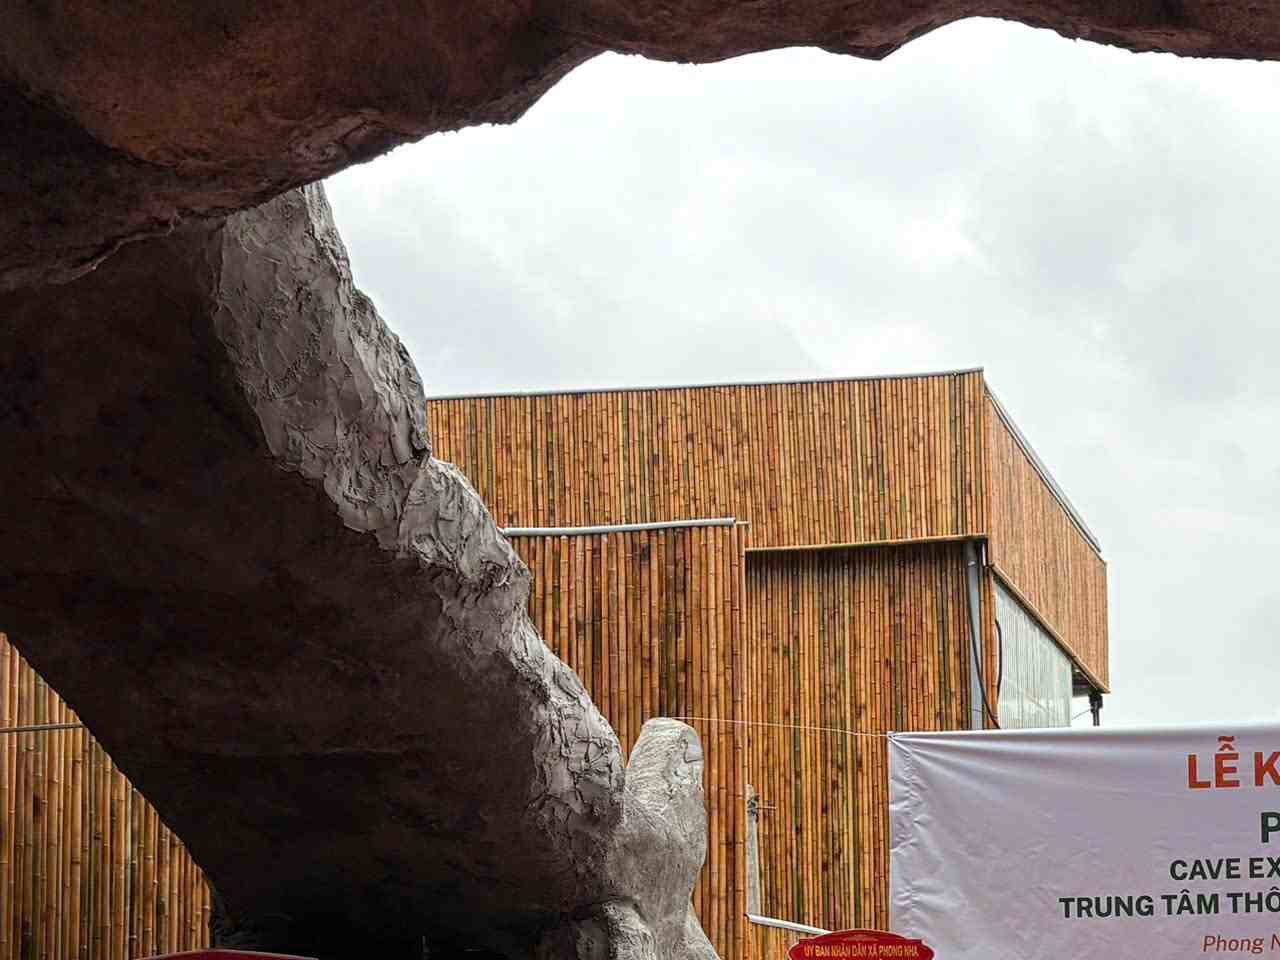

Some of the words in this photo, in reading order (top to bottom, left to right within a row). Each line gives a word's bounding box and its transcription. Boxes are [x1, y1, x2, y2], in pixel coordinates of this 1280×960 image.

[1187, 735, 1240, 789] LỄ
[1169, 857, 1242, 881] CAVE
[1058, 894, 1155, 919] TRUNG
[1161, 887, 1220, 915] TÂM
[879, 944, 904, 957] PHONG
[905, 944, 920, 958] NHA
[1202, 933, 1265, 955] Phong
